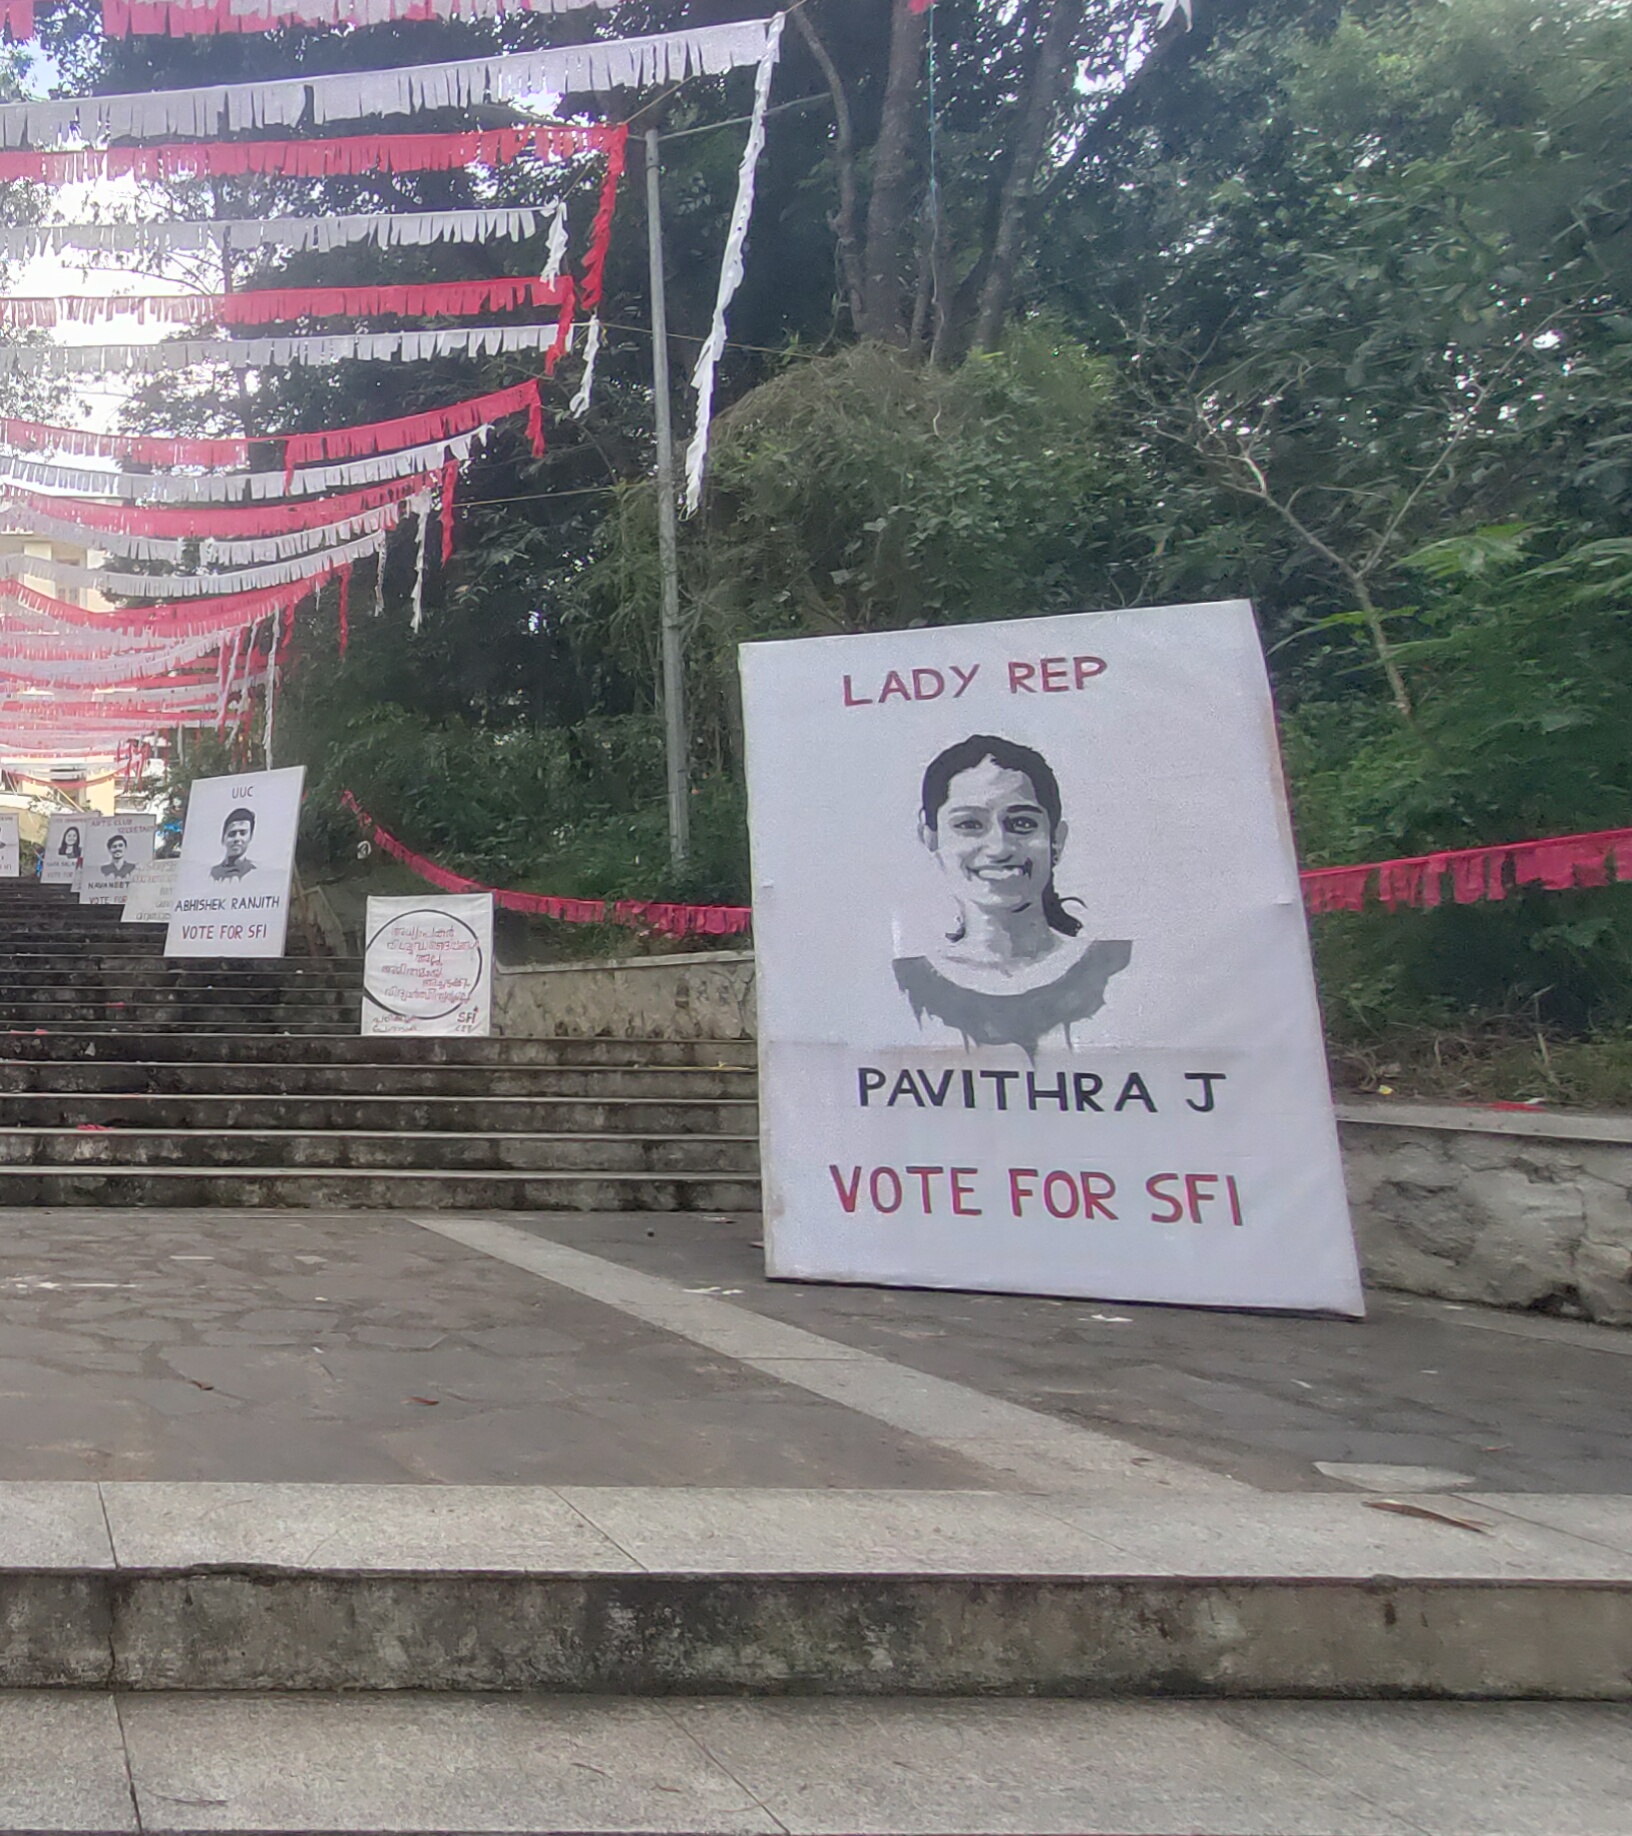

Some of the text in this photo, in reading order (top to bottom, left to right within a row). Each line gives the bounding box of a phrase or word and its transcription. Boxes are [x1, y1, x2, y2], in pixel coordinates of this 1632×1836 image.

[843, 656, 1108, 707] LADY REP
[231, 786, 254, 799] UUC
[114, 819, 133, 827] CLUB
[89, 896, 109, 904] VOTE
[175, 898, 226, 912] ABHISHEK
[231, 896, 280, 910] RANJITH
[182, 924, 267, 939] VOTE FOR SFI
[457, 1011, 476, 1024] SFI
[858, 1067, 1227, 1114] PAVITHRA J
[829, 1164, 1244, 1226] VOTE FOR SFI
